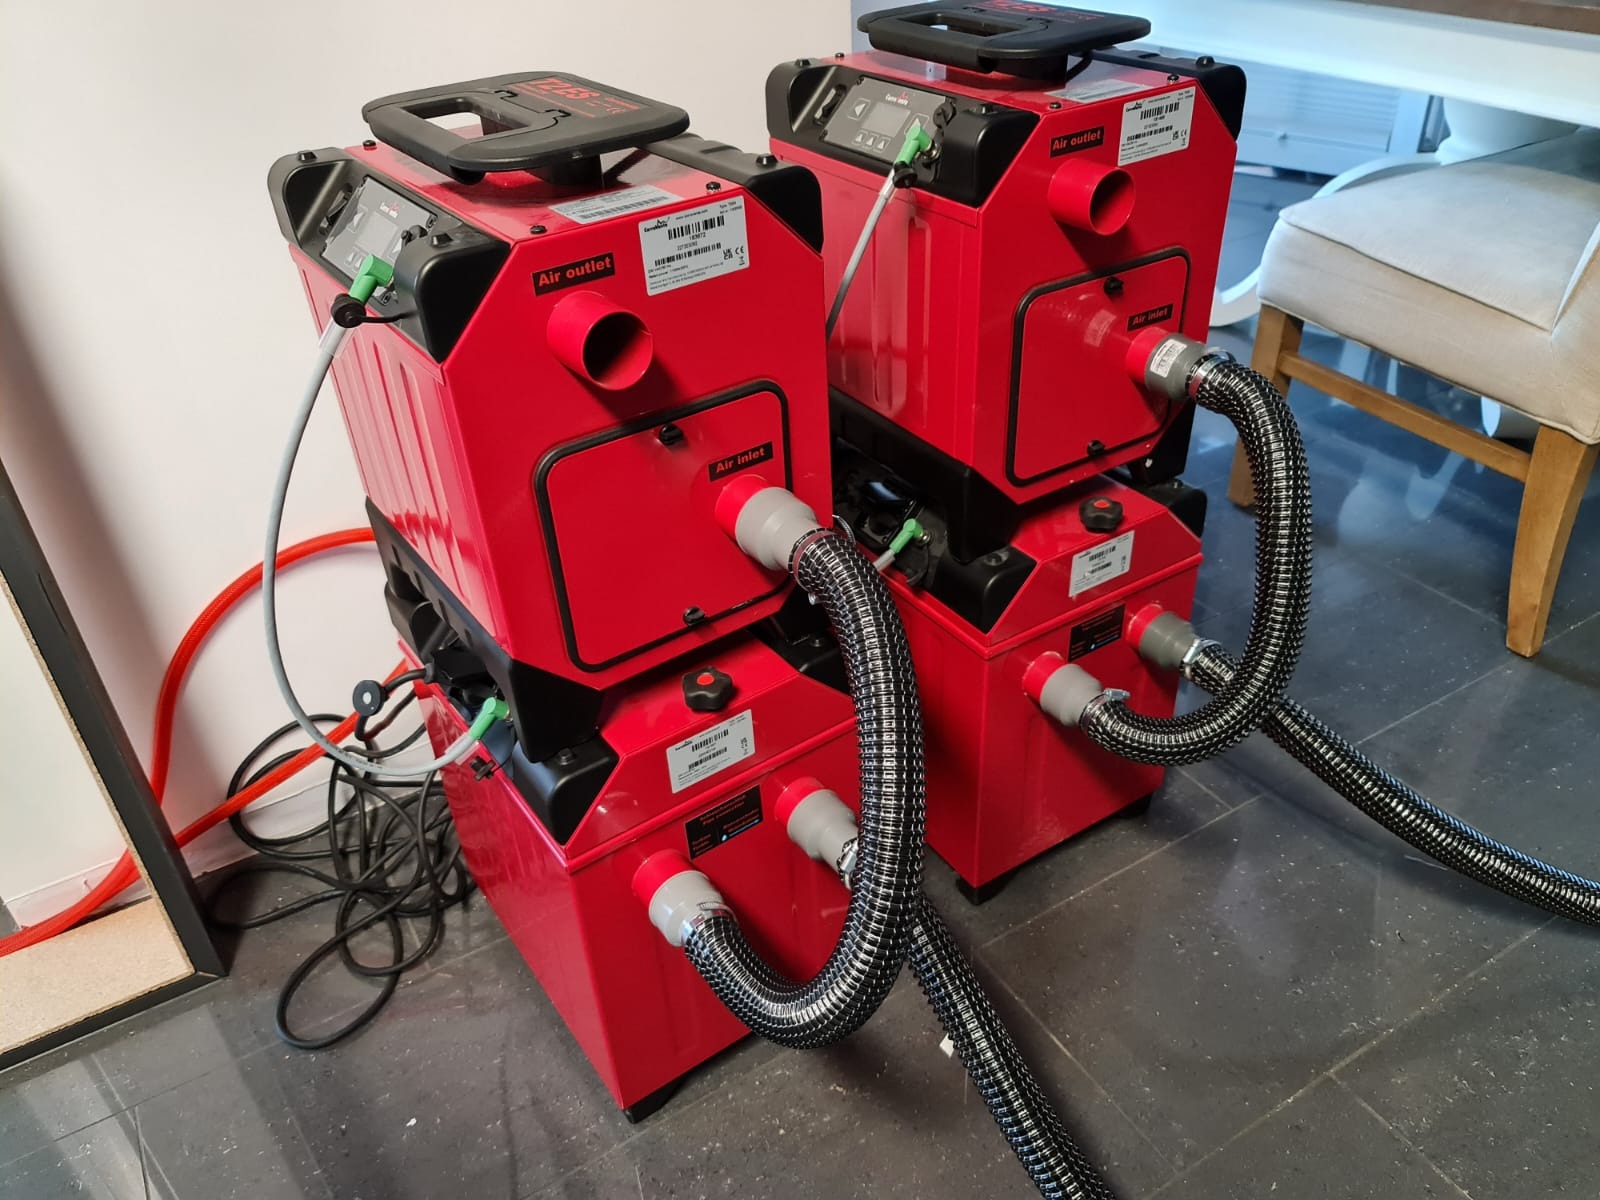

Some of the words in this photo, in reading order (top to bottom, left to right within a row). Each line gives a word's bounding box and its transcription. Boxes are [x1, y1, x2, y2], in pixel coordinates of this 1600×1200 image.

[1052, 137, 1068, 151] Air
[1070, 129, 1101, 146] outlet
[538, 271, 561, 287] Air
[565, 256, 612, 279] outlet
[1132, 315, 1146, 325] Air
[1147, 307, 1168, 321] inlet
[716, 459, 735, 473] Air
[737, 447, 765, 465] inlet
